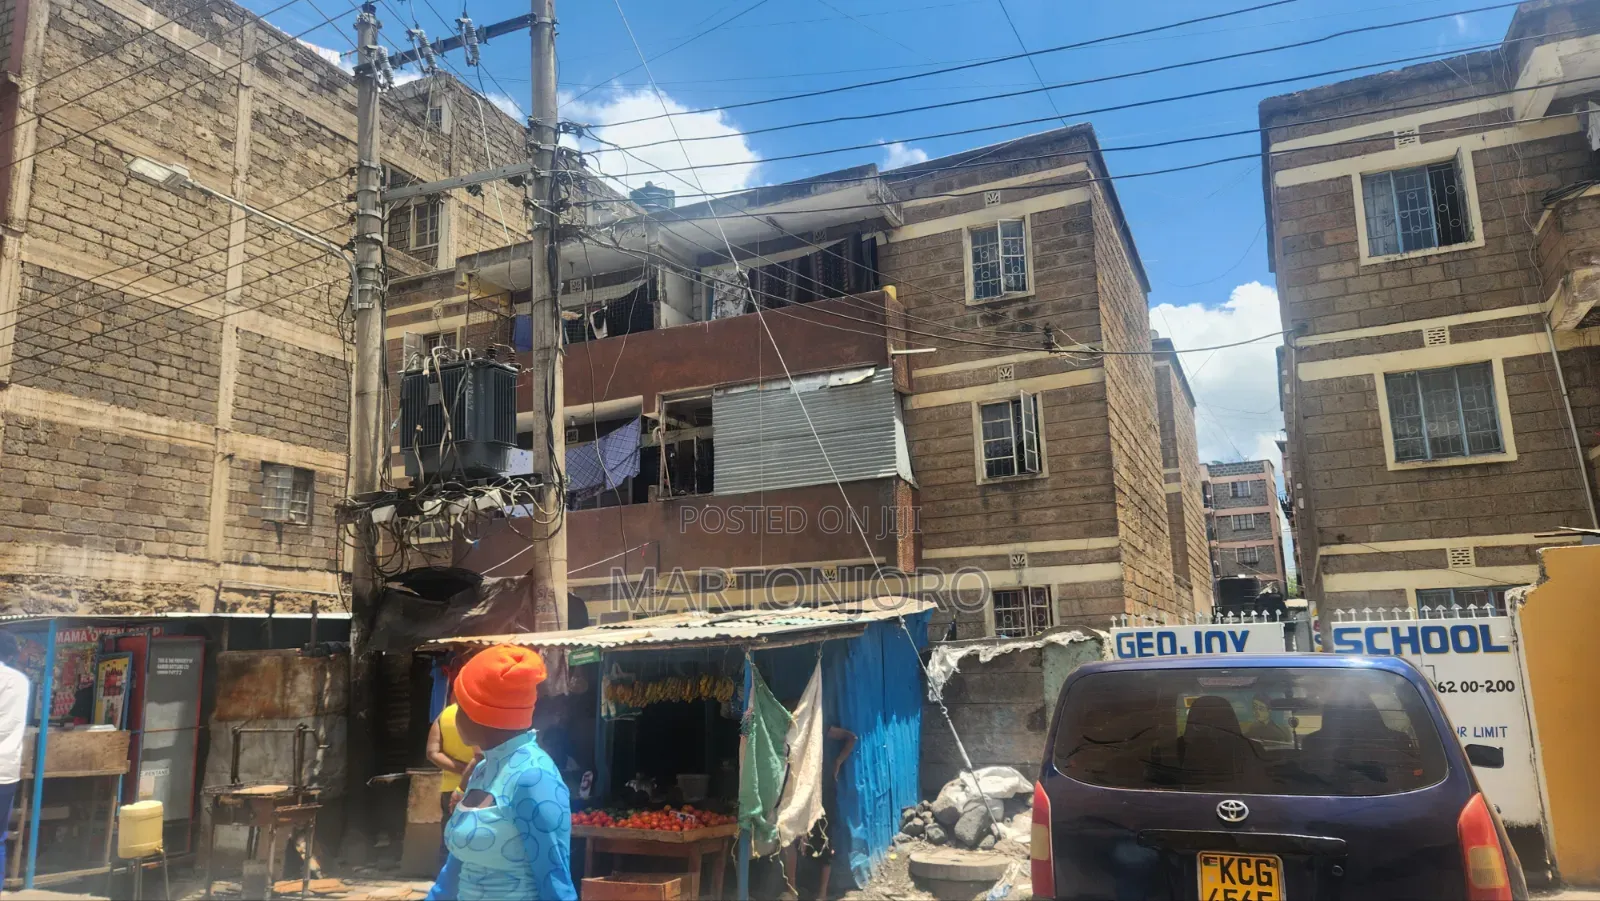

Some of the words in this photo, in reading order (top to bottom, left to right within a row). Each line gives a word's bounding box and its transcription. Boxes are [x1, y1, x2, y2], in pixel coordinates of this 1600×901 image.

[56, 630, 88, 644] MAMA
[1332, 624, 1510, 655] SCHOOL
[1473, 726, 1508, 738] LIMIT
[1219, 856, 1273, 887] KCG
